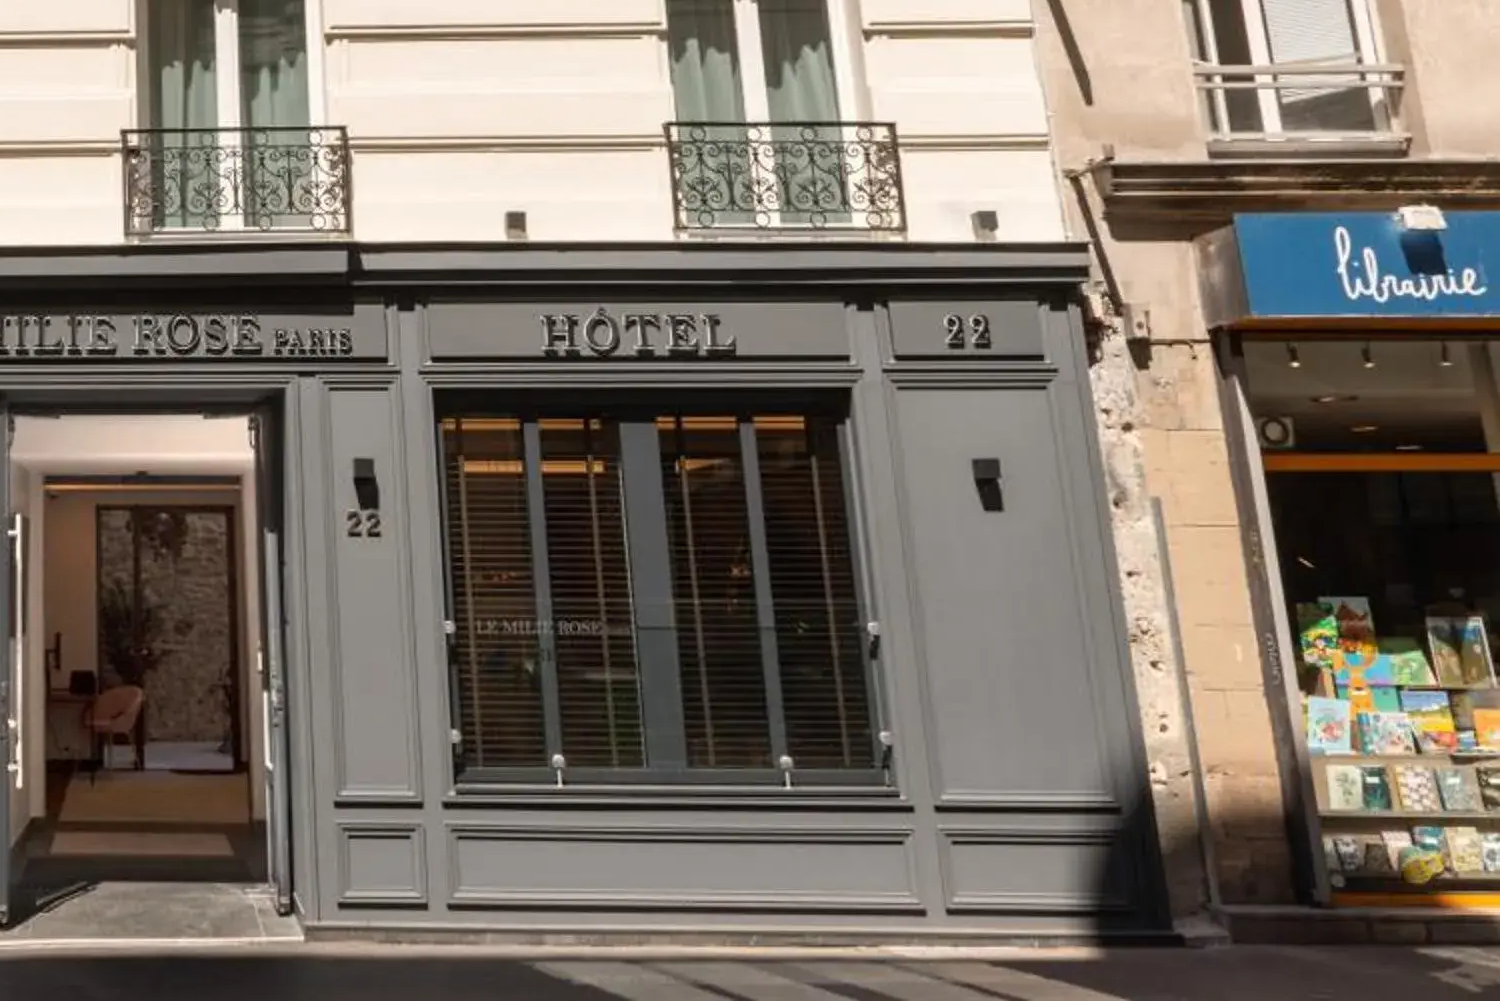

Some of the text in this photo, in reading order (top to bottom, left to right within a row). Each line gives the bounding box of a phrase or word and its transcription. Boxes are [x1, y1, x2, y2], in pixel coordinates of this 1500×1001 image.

[1335, 226, 1487, 302] librairie
[132, 315, 263, 356] ROSE
[274, 328, 353, 356] PARIS
[540, 307, 737, 357] HÔTEL
[943, 313, 992, 349] 22
[346, 510, 382, 538] 22
